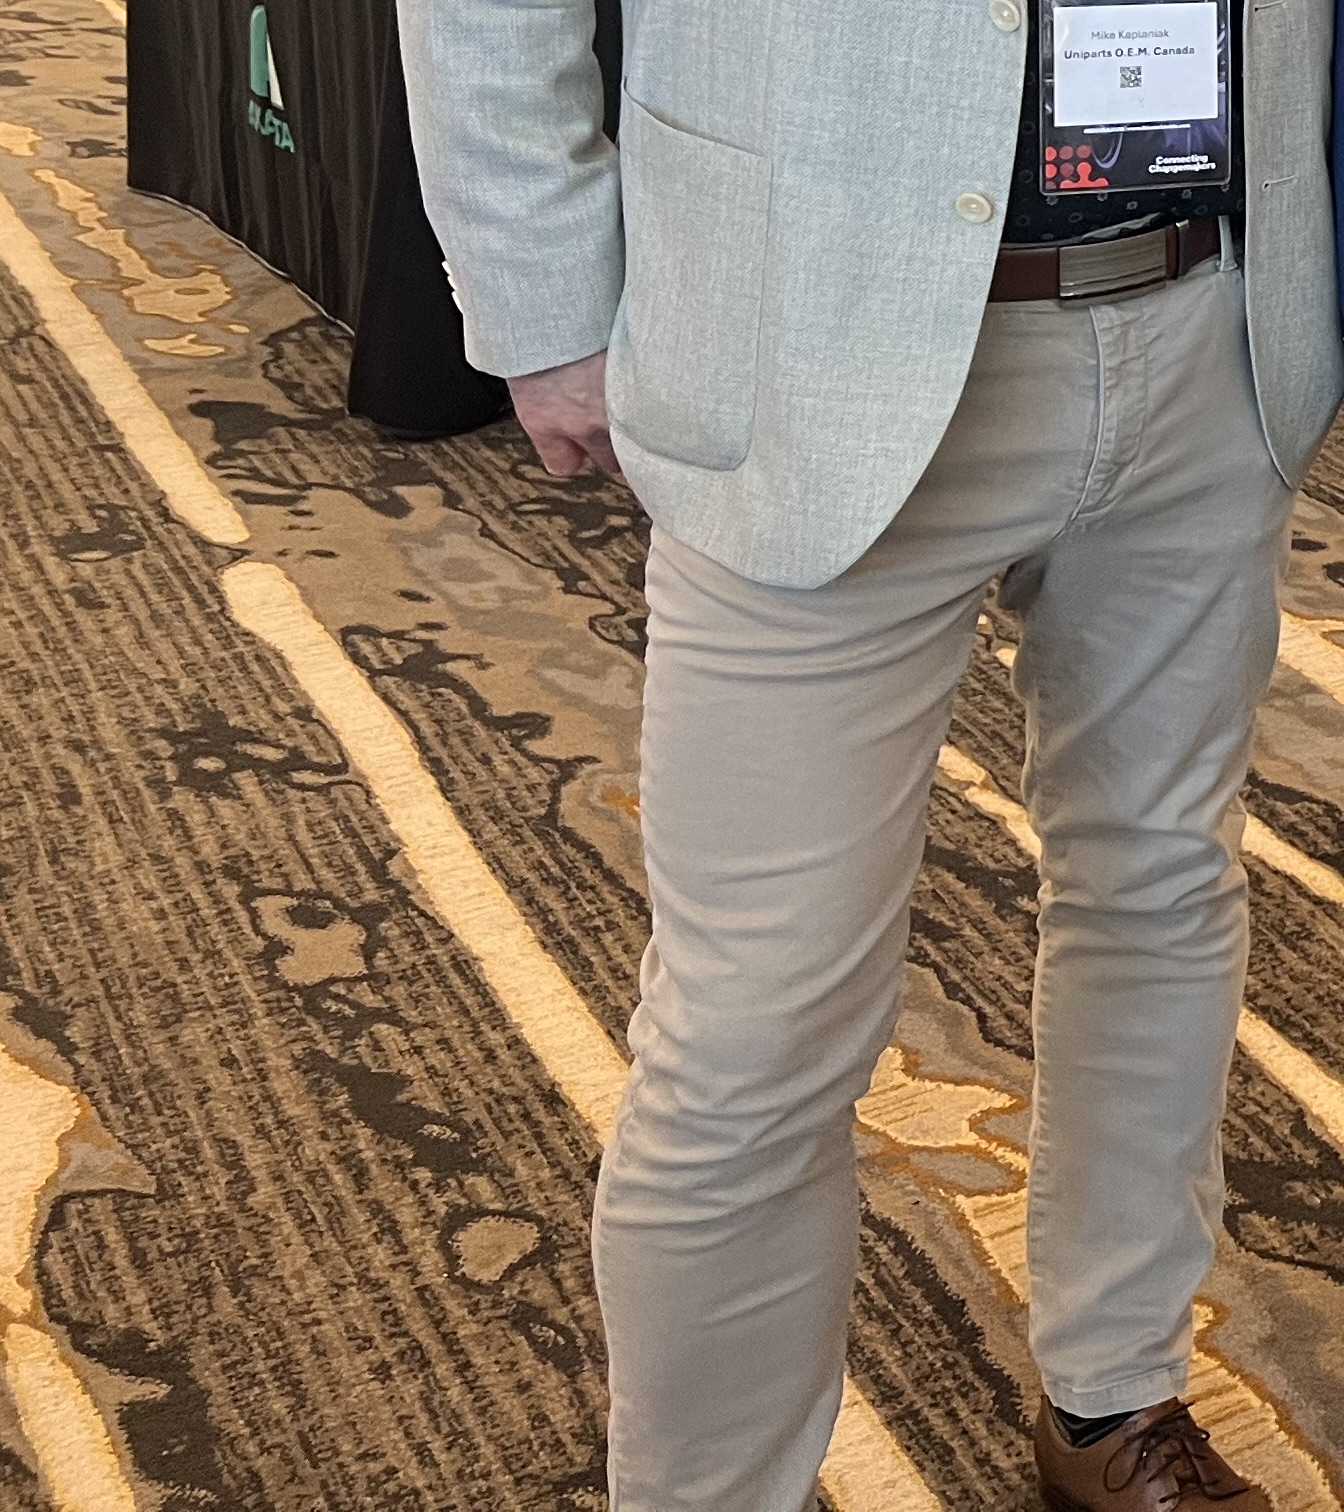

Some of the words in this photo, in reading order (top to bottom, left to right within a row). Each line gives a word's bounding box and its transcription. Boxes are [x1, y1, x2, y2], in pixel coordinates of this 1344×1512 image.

[1091, 30, 1116, 40] Mike
[1064, 47, 1113, 60] Uniparts
[1115, 46, 1151, 58] O.E.M.
[1153, 45, 1195, 57] Canada
[1155, 153, 1209, 165] Connecting
[1148, 161, 1217, 174] Changemakers
